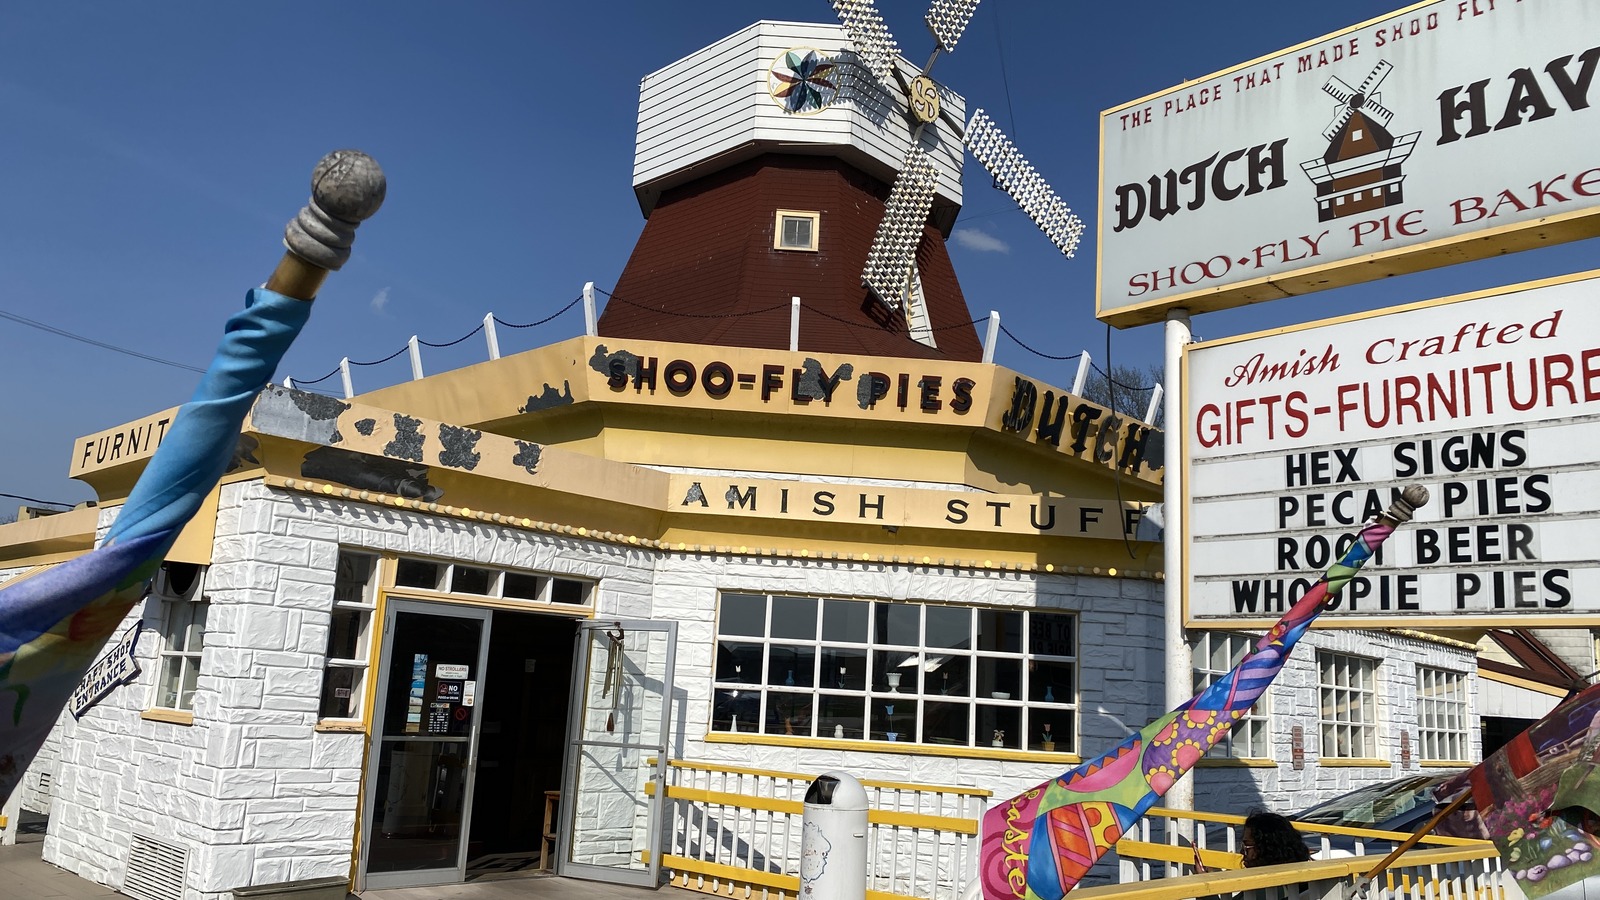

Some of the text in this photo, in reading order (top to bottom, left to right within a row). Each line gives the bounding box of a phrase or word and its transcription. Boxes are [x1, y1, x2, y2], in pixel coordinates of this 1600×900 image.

[1120, 107, 1152, 131] THE
[1164, 85, 1222, 123] PLACE
[1233, 62, 1284, 94] THAT
[1298, 38, 1361, 74] MADE
[1375, 12, 1439, 48] SHOO
[1113, 46, 1600, 233] DUTCH HAV
[1349, 209, 1428, 248] PIE
[1224, 309, 1564, 388] Amish Crafted
[607, 356, 976, 412] SHOO-FLY PIES
[1003, 376, 1150, 472] DUTCH
[1286, 430, 1527, 487] HEX SIGNS
[681, 481, 1148, 534] AMISH STUFF
[1443, 474, 1552, 518] PIES
[1416, 523, 1537, 565] BEER
[1456, 569, 1572, 610] PIES
[107, 640, 131, 669] SHOP
[76, 658, 127, 710] ENTRANCE
